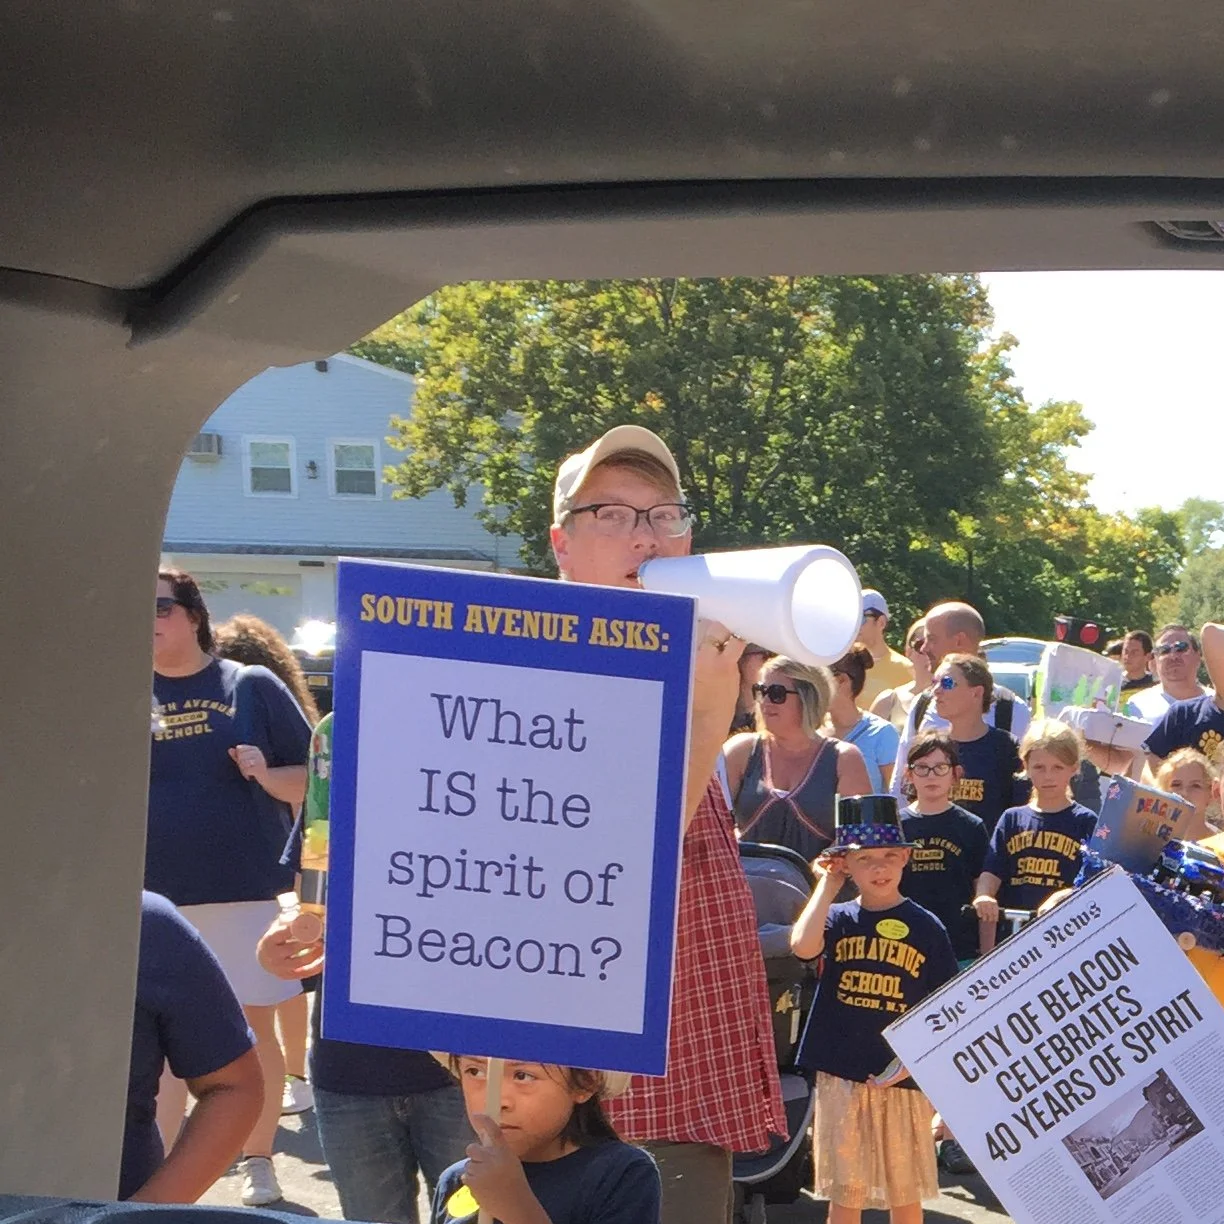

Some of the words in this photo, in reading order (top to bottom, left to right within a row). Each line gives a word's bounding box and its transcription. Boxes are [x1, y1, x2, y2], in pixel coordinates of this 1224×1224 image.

[361, 594, 453, 630] SOUTH
[463, 604, 579, 643] AVENUE
[588, 616, 670, 653] ASKS:
[154, 724, 214, 741] SCHOOL
[430, 692, 587, 753] What
[418, 767, 476, 817] IS
[496, 776, 591, 829] the
[911, 861, 946, 872] SCHOOL
[929, 836, 962, 857] AVENUE
[1035, 830, 1081, 861] AVENUE
[387, 848, 546, 899] spirit
[563, 862, 624, 907] of
[373, 913, 622, 981] Beacon?
[866, 937, 926, 979] AVENUE
[919, 999, 968, 1034] The
[966, 945, 1043, 1001] Beacon
[1042, 900, 1102, 949] News
[838, 970, 904, 999] SCHOOL
[952, 1024, 1013, 1084] CITY
[1006, 1001, 1043, 1045] OF
[1037, 936, 1140, 1023] BEACON
[995, 984, 1143, 1103] CELEBRATES
[984, 1122, 1022, 1163] 40
[1011, 1068, 1097, 1140] YEARS
[1088, 1043, 1126, 1087] OF
[1120, 988, 1204, 1064] SPIRIT
